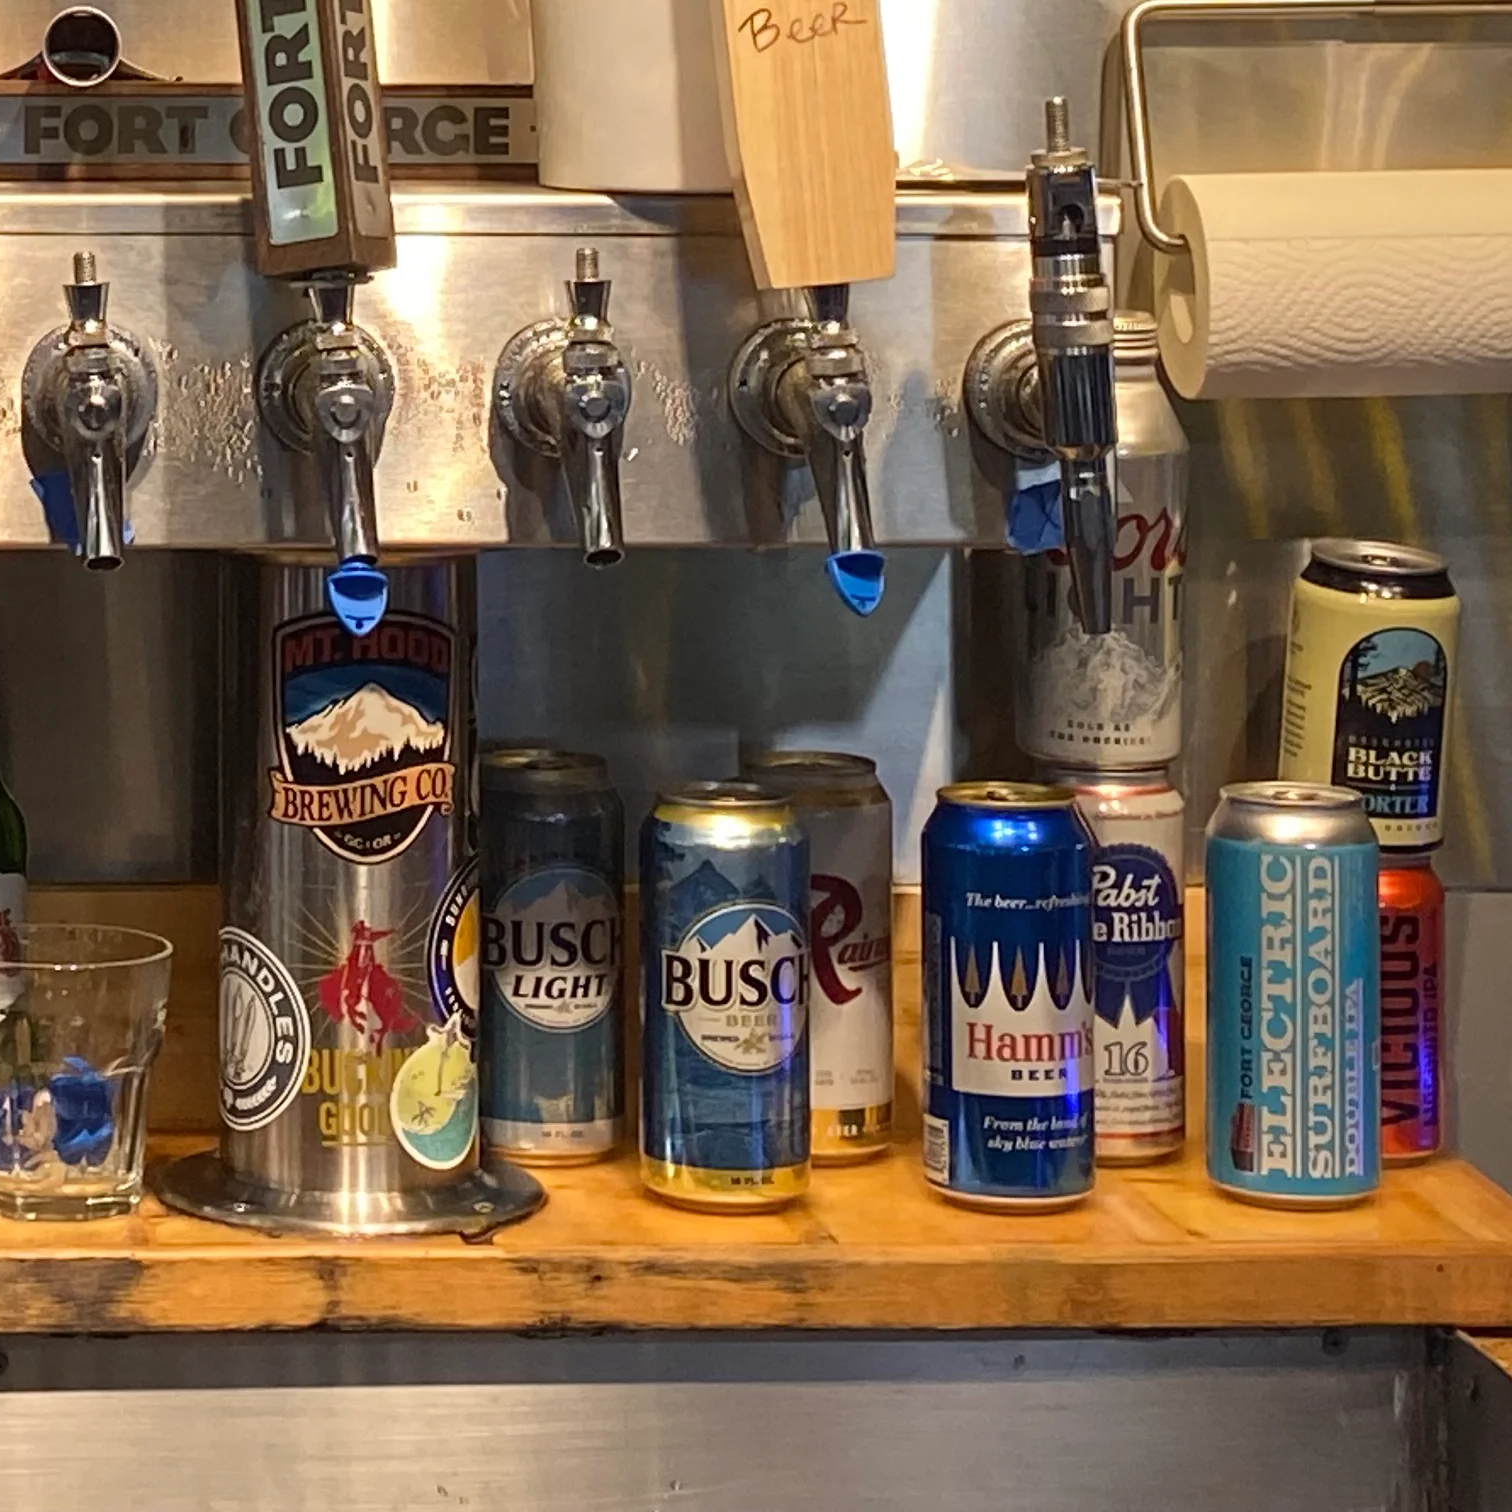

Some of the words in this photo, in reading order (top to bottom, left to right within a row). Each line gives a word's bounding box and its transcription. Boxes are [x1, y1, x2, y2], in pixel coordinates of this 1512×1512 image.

[23, 105, 208, 155] FORT
[352, 627, 450, 673] HOOD
[1347, 762, 1432, 782] BUTTE
[1348, 746, 1432, 767] BLACK
[282, 776, 408, 821] BREWING
[415, 767, 450, 800] CO.
[1359, 794, 1429, 816] ORTER
[965, 892, 992, 908] The
[511, 974, 609, 1000] LIGHT
[1240, 955, 1254, 1041] GEORGE
[1345, 980, 1360, 1034] IPA
[725, 1013, 778, 1028] BEER
[1260, 854, 1295, 1179] ELECTRIC
[1308, 856, 1334, 1180] SURFBOARD
[1380, 915, 1421, 1126] VICIOUS
[967, 1020, 1094, 1064] Hamm's
[1103, 1040, 1150, 1078] 16
[1010, 1068, 1069, 1082] BEER
[1240, 1047, 1254, 1100] FORT
[1345, 1040, 1360, 1177] DOUBLE
